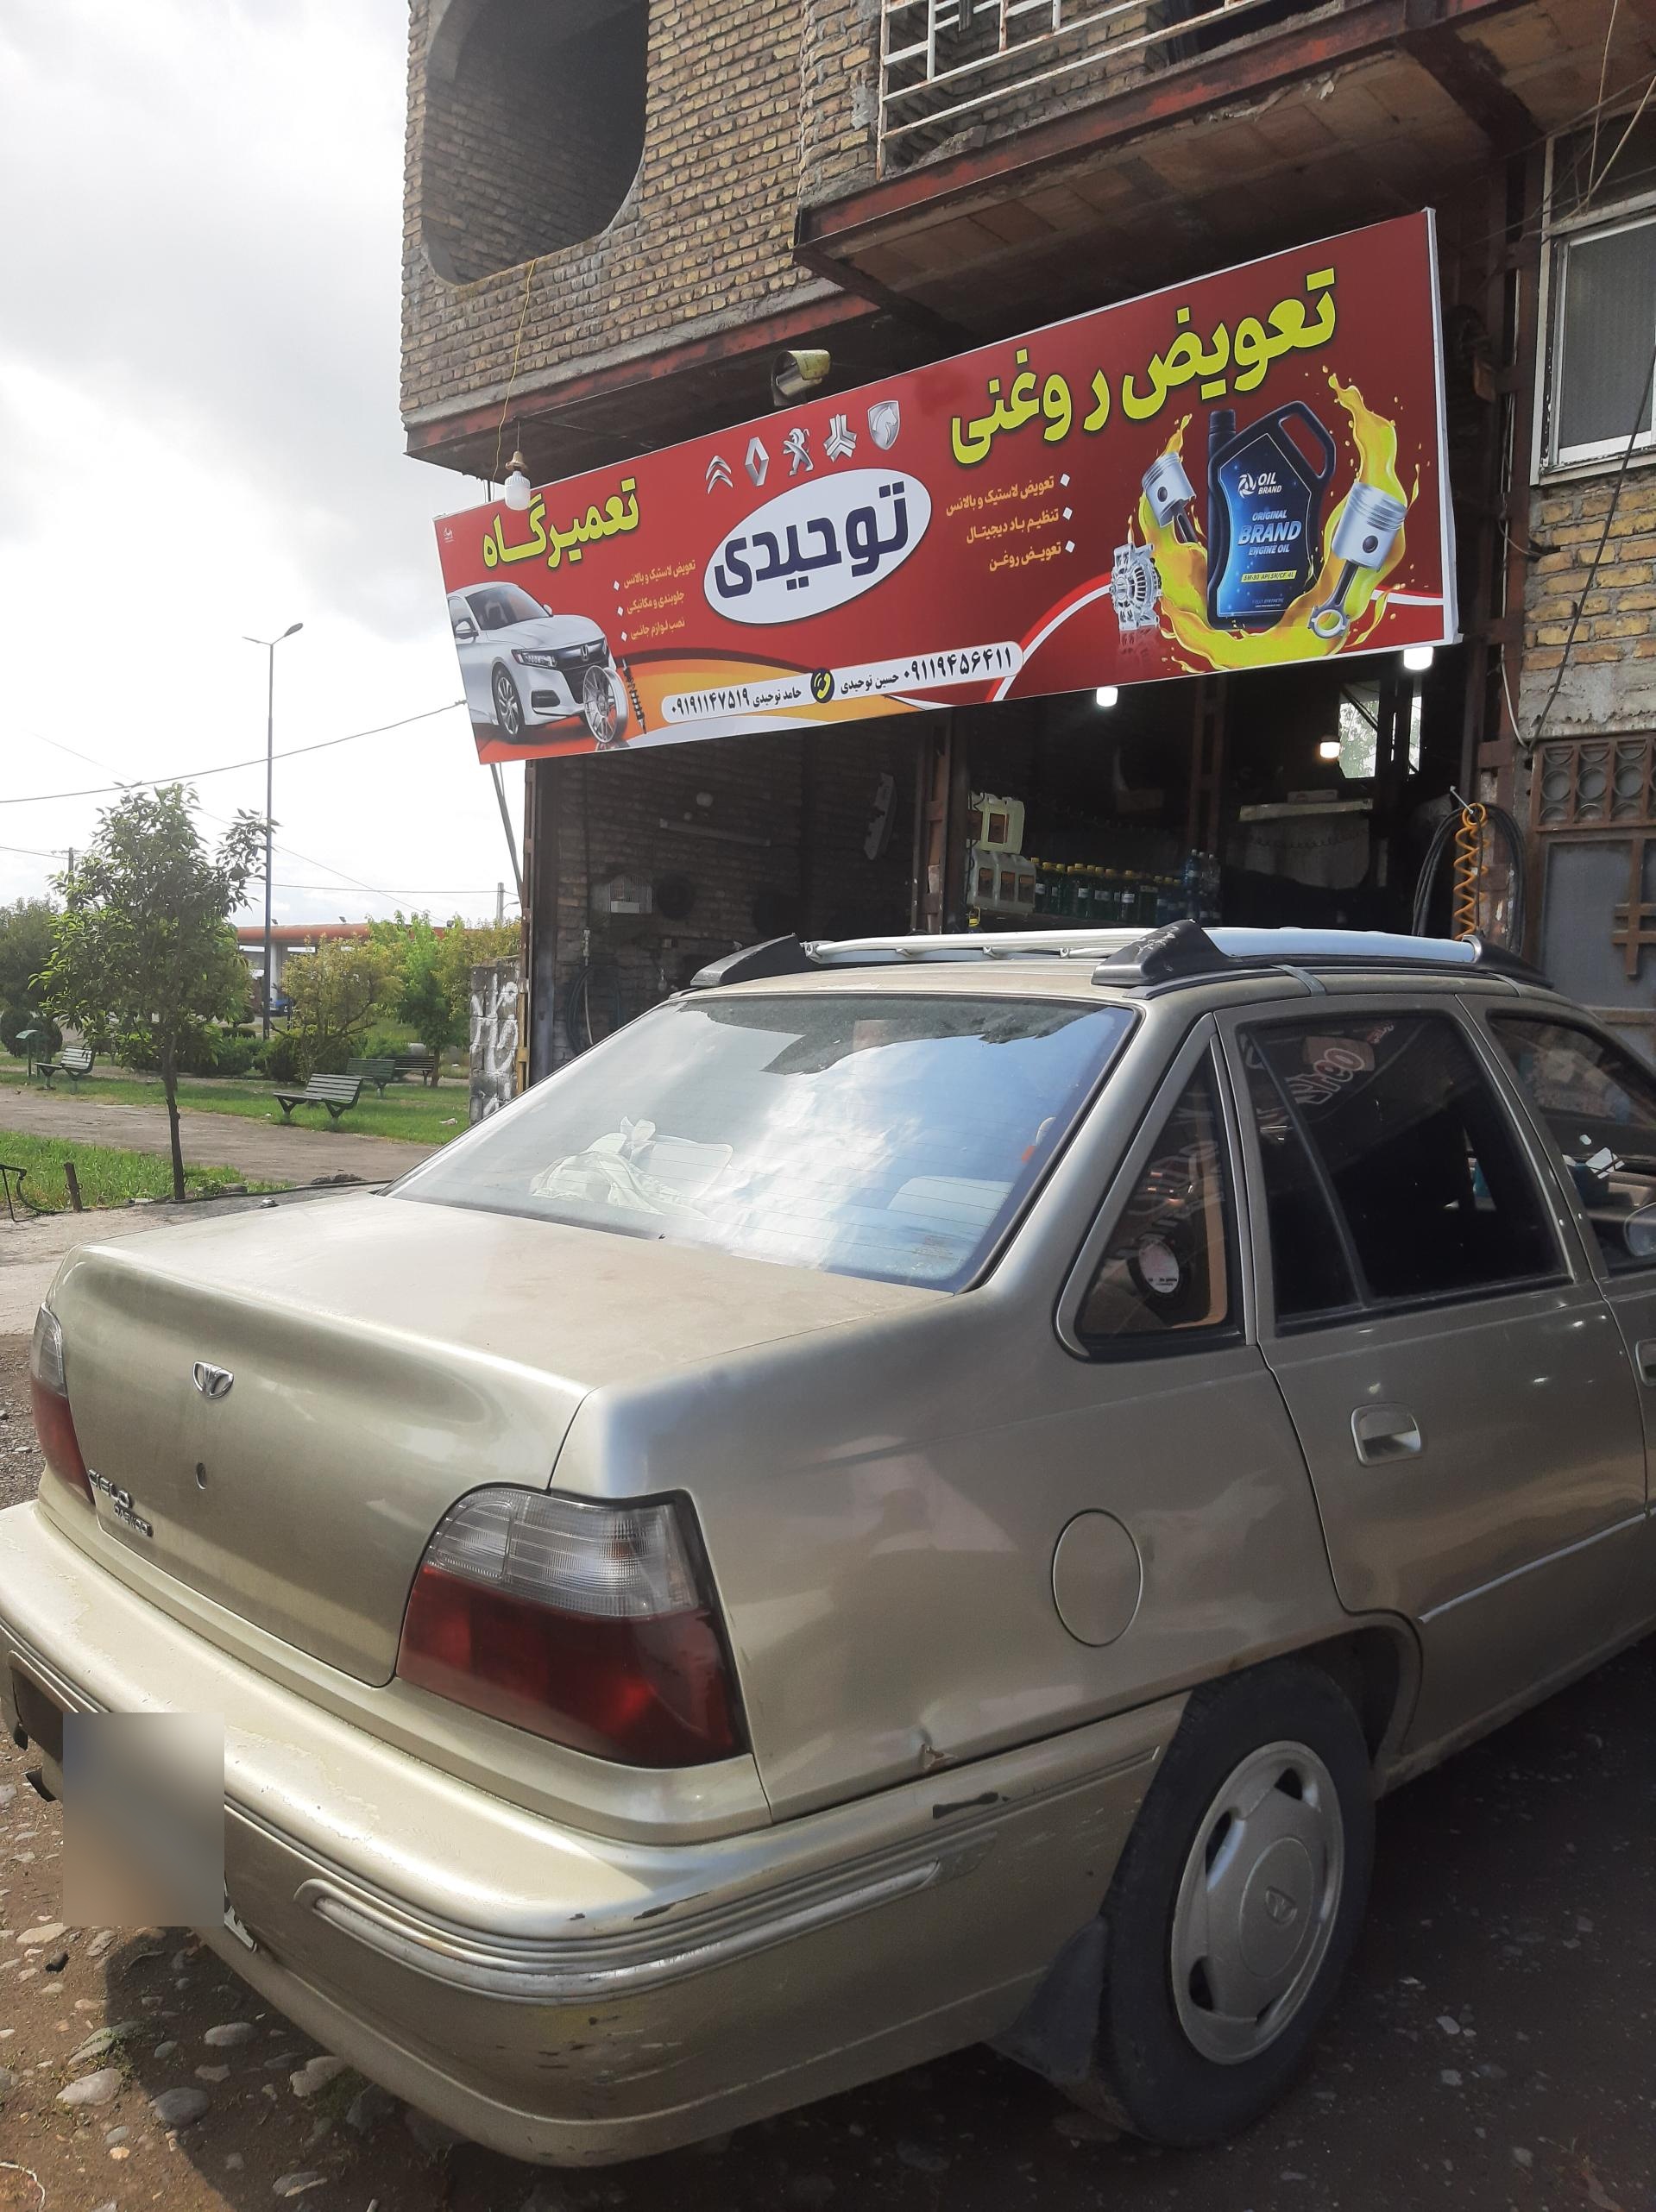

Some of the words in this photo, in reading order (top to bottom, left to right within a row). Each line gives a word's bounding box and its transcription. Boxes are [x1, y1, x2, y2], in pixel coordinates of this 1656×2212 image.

[1122, 267, 1336, 420] تعویض
[1020, 475, 1055, 499] تعویض
[1257, 472, 1277, 485] OIL
[985, 484, 1018, 506] لاستیک
[1258, 485, 1282, 495] BRAND
[946, 494, 976, 516] بالانس
[978, 498, 984, 509] و
[483, 477, 639, 569] تعمیرگاه
[1010, 516, 1025, 532] باد
[1027, 508, 1059, 532] تنظیم
[1252, 509, 1288, 521] ORIGINAL
[715, 481, 909, 599] توحیدی
[967, 523, 1008, 544] دیجیتال
[1237, 521, 1302, 545] BRAND
[1021, 541, 1061, 565] تعویض
[1249, 544, 1277, 556] ENGINE
[1278, 544, 1290, 554] OIL
[673, 559, 696, 577] تعویض
[989, 550, 1019, 571] روغن
[624, 573, 644, 588] بالانس
[650, 565, 671, 581] لاستیک
[627, 597, 652, 614] مکانیکی
[658, 590, 685, 607] جلوبندی
[630, 625, 650, 640] جانبی
[651, 619, 669, 638] لوازم
[670, 617, 685, 632] نصب
[904, 646, 1011, 682] ۰۹۱۱۹۴۵۶۴۱۱
[841, 676, 873, 695] توحیدی
[876, 673, 899, 689] حسین
[671, 688, 750, 715] ۰۹۱۹۱۱۴۷۵۱۹
[753, 689, 781, 708] توحیدی
[783, 686, 802, 700] حامد
[88, 1468, 131, 1509] CIELO
